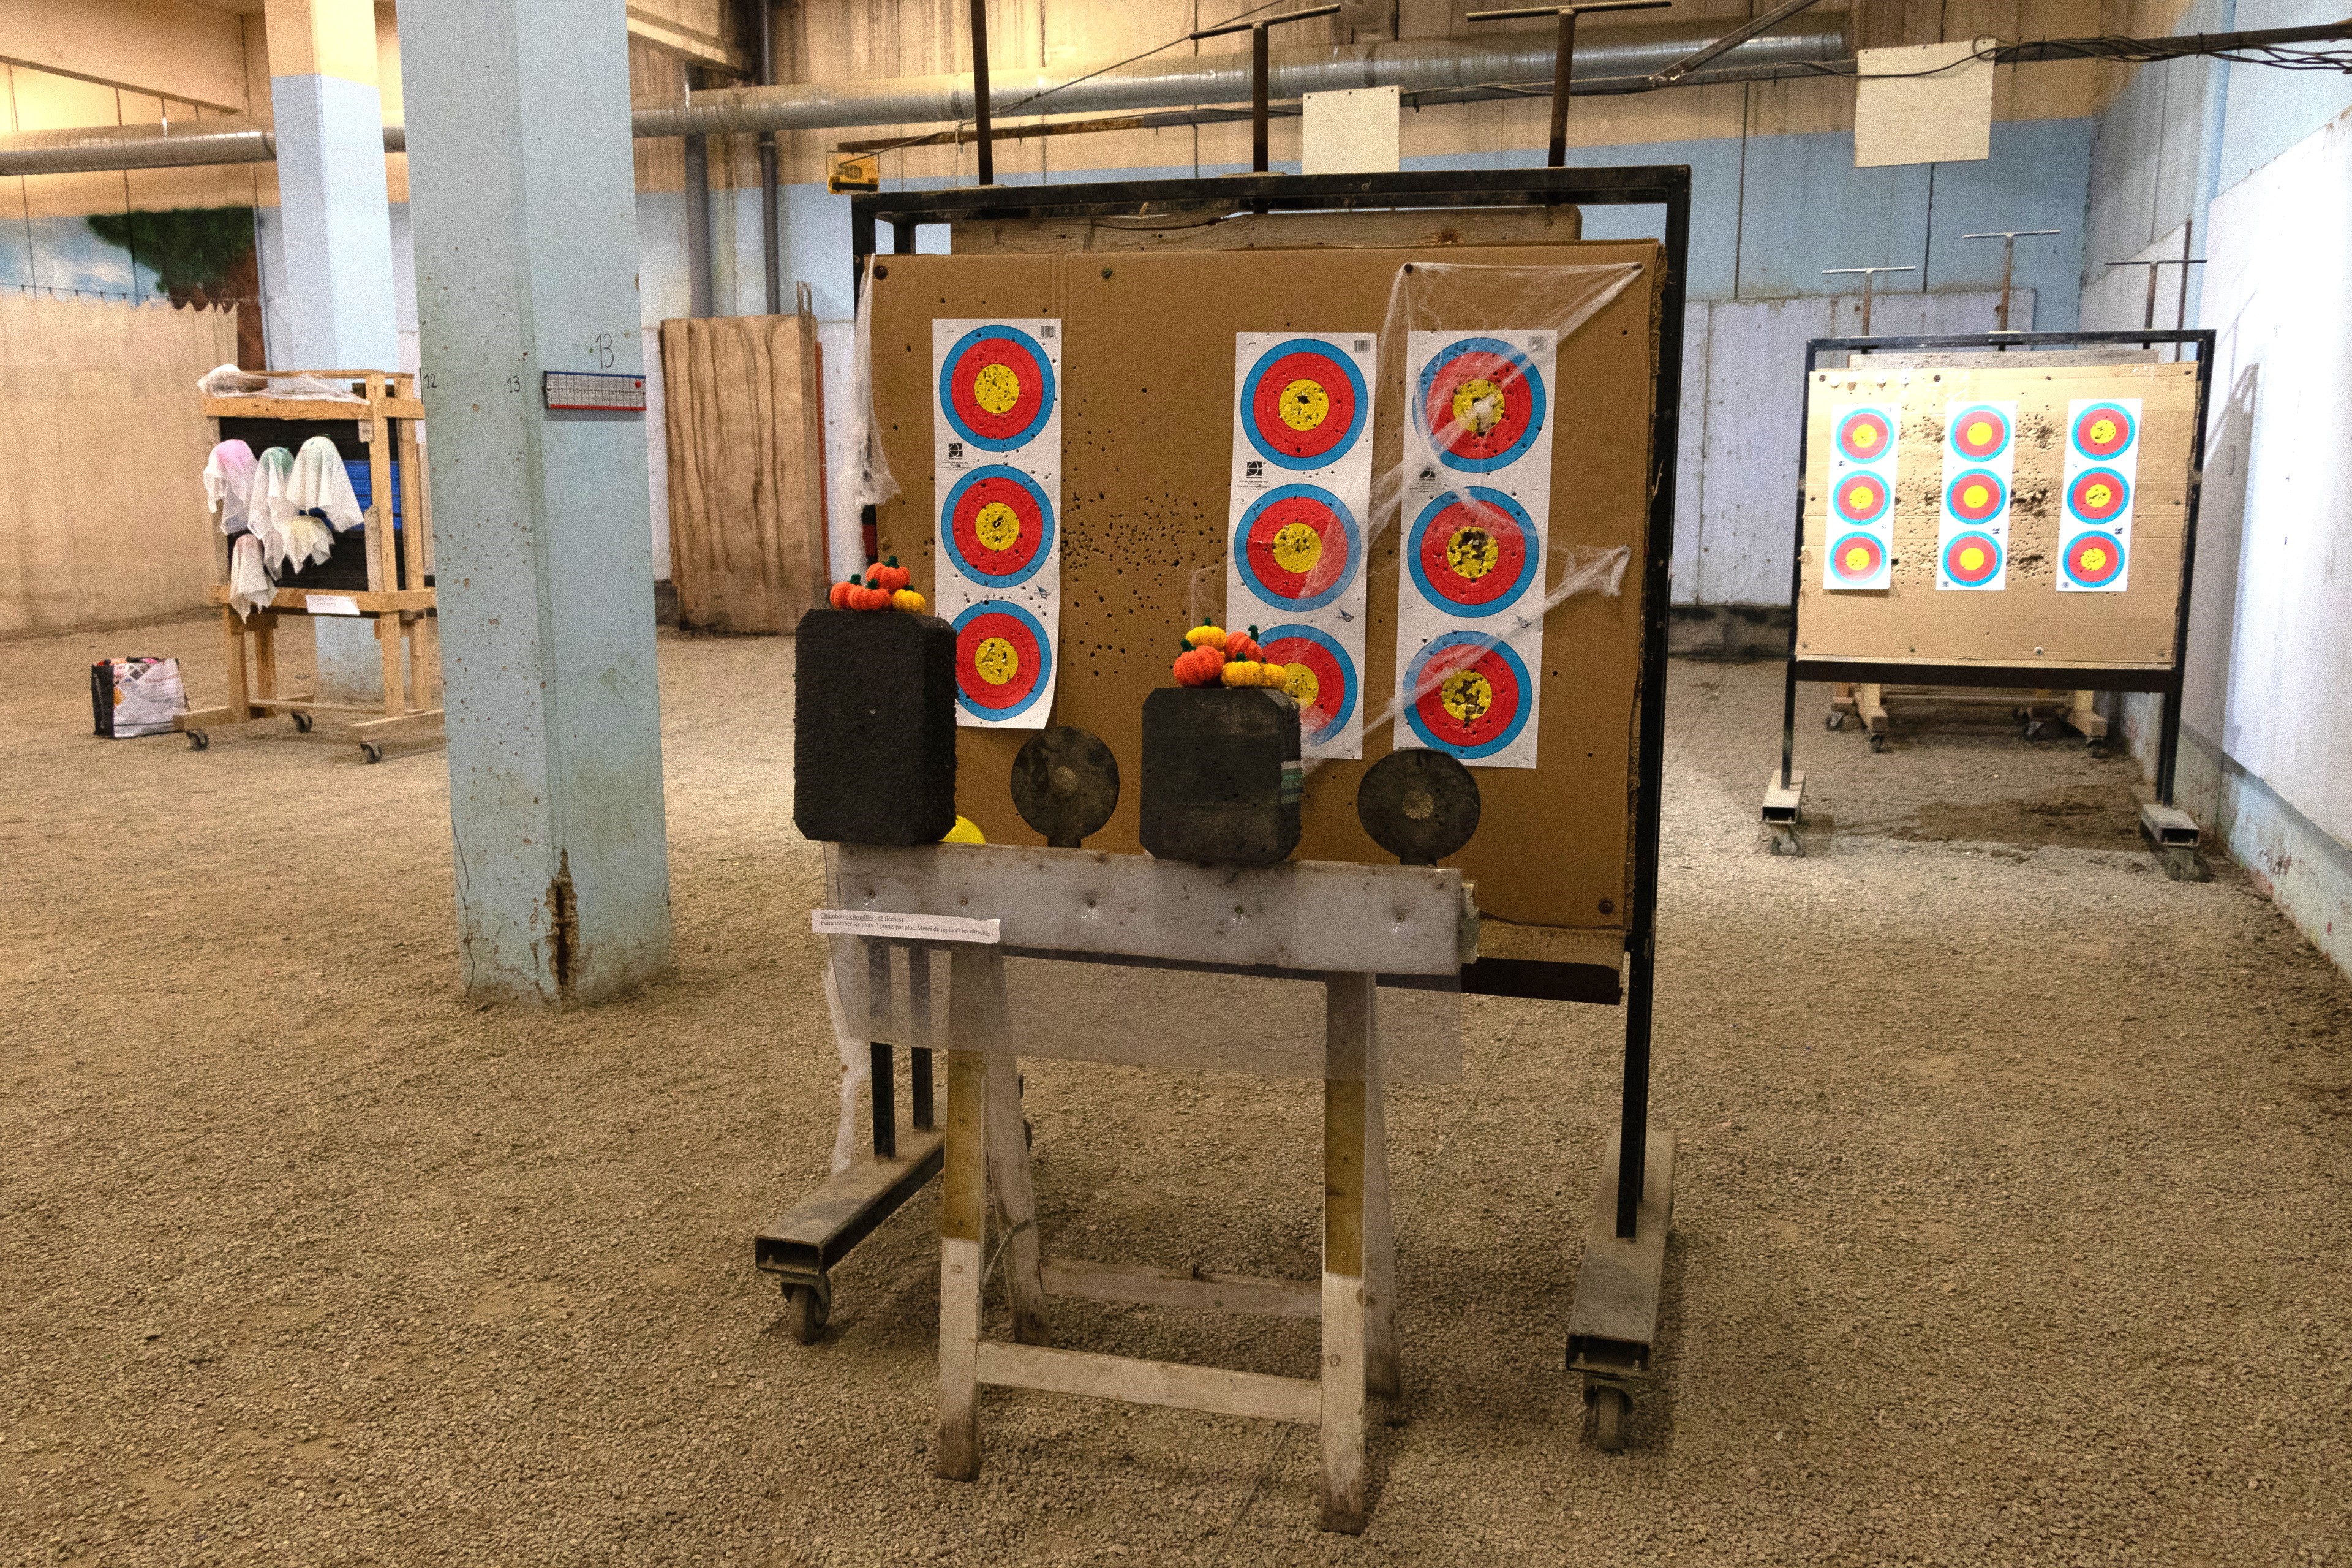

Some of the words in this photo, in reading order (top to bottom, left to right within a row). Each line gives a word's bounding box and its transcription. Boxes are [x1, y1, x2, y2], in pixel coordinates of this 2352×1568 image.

[595, 333, 614, 369] 13
[424, 373, 439, 389] 12
[506, 375, 521, 394] 13
[970, 929, 991, 937] citrouilles
